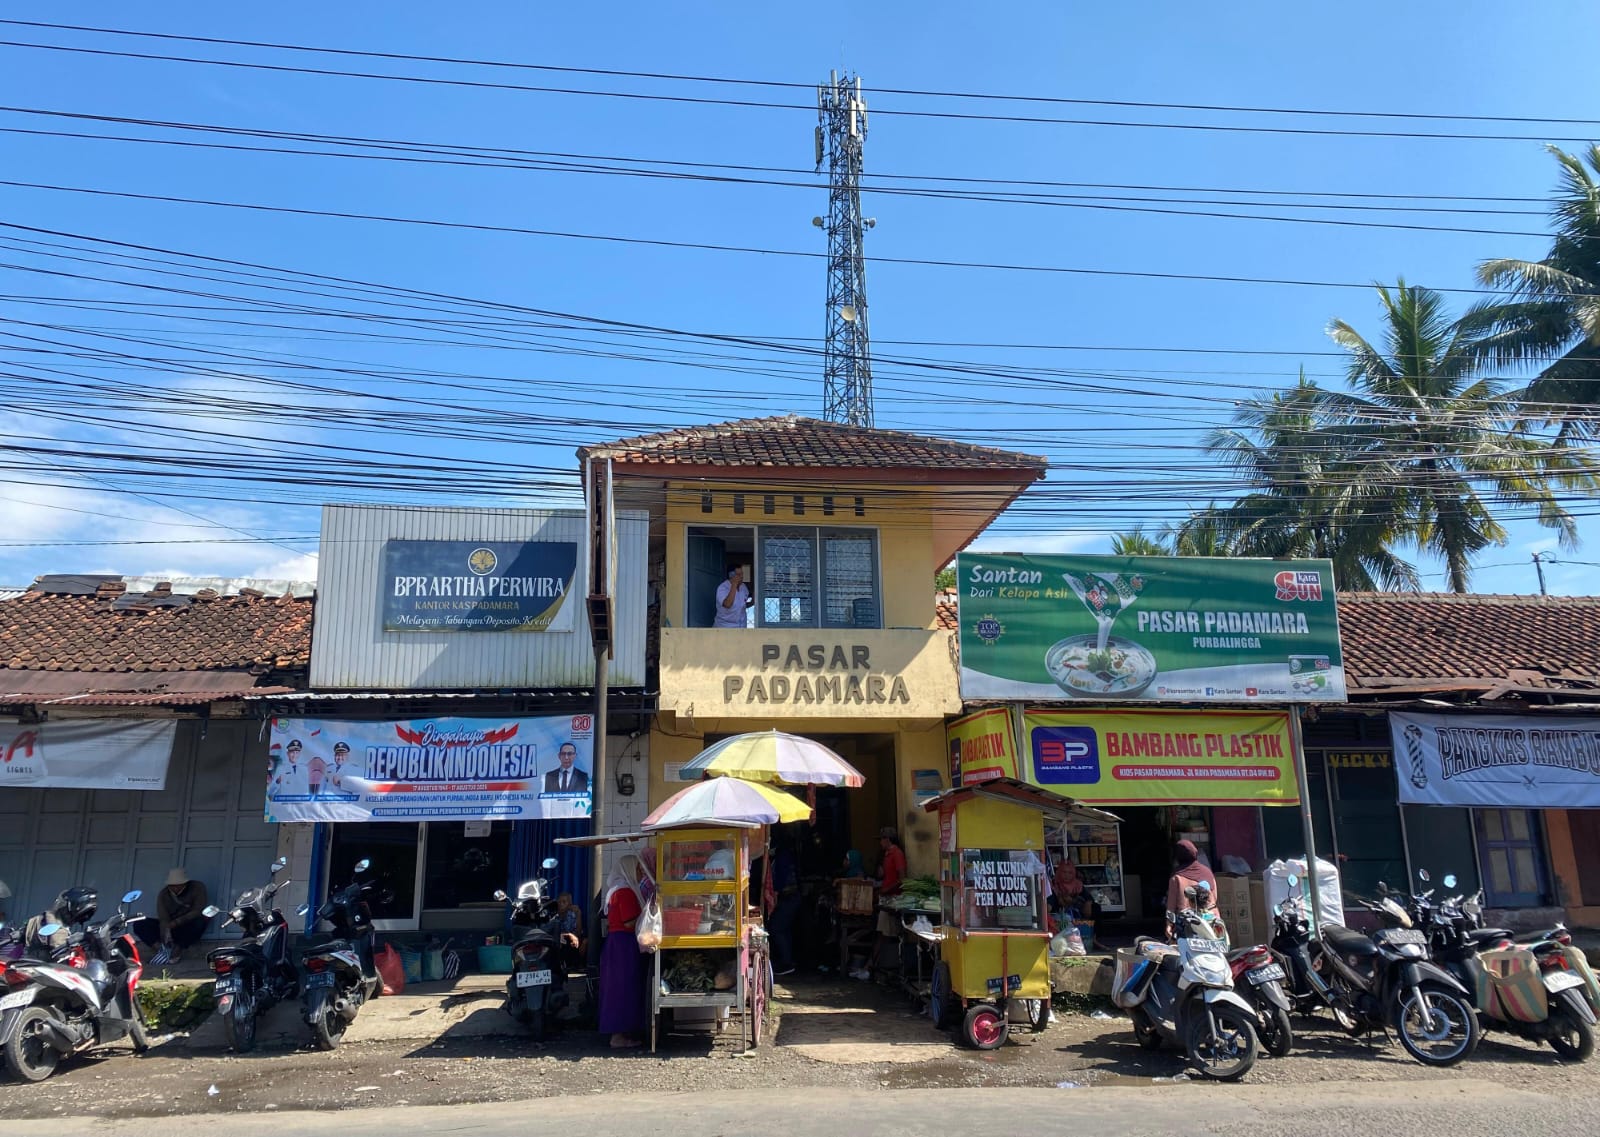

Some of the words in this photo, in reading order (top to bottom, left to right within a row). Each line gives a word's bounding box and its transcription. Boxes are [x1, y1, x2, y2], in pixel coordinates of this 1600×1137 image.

[969, 564, 1042, 584] Santan
[394, 576, 427, 597] BPR
[428, 576, 485, 597] ARTHA
[488, 577, 566, 598] PERWIRA
[970, 587, 994, 598] Dari
[999, 586, 1040, 603] Kelapa
[1045, 587, 1068, 599] Asli
[415, 601, 450, 610] KANTOR
[452, 601, 471, 610] KAS
[471, 601, 519, 610] PADAMARA
[521, 616, 552, 626] Kredit
[980, 622, 998, 630] TOP
[1137, 611, 1200, 633] PASAR
[1205, 612, 1310, 634] PADAMARA
[1193, 637, 1261, 649] PURBALINGGA
[760, 644, 871, 671] PASAR
[723, 675, 910, 704] PADAMARA
[421, 721, 485, 749] Dirgahayu
[1106, 732, 1203, 758] BAMBANG
[1204, 733, 1284, 758] PLASTIK
[1434, 728, 1530, 780] PANGKAS
[6, 766, 33, 774] LIGHTS
[364, 746, 448, 782] REPUBLIK
[448, 744, 538, 781] INDONESIA
[1134, 768, 1153, 777] PASAR
[1194, 768, 1210, 776] RAYA
[1209, 768, 1241, 776] PADAMARA
[972, 860, 995, 875] NASI
[997, 861, 1032, 875] KUNIN
[974, 876, 997, 891] NASI
[1000, 876, 1028, 891] UDUK
[975, 892, 994, 907] TEH
[996, 892, 1028, 907] MANIS
